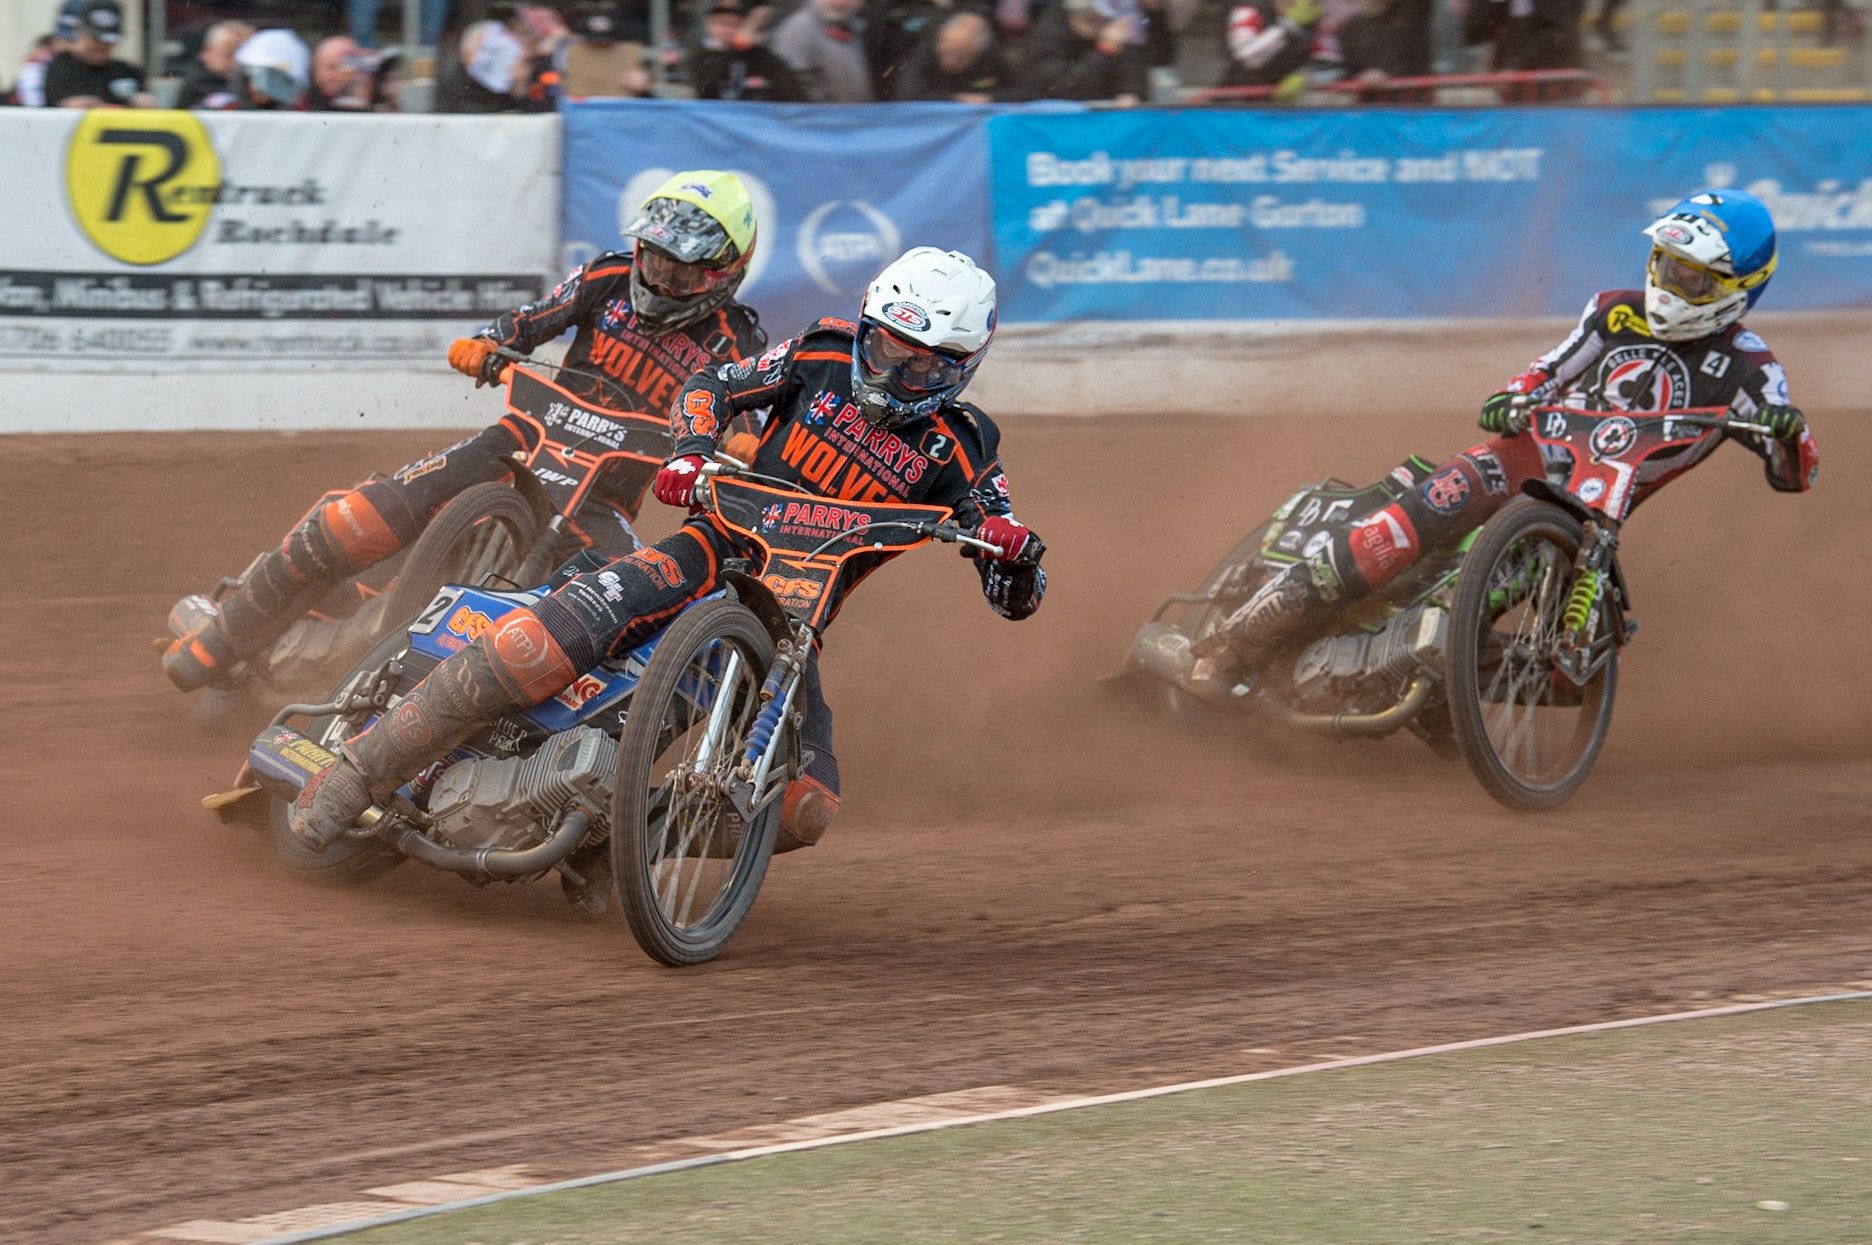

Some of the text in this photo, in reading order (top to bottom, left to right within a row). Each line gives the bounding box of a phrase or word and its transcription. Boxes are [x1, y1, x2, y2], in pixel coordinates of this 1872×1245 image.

[1026, 151, 1111, 186] Book
[1112, 157, 1187, 189] your
[1189, 154, 1267, 183] next
[1271, 150, 1388, 183] Service
[1395, 151, 1457, 183] and
[1071, 195, 1157, 234] Quick
[1160, 195, 1243, 229] Lane
[889, 306, 923, 326] STS
[833, 403, 927, 484] PARRYS
[929, 434, 947, 459] 2
[781, 421, 905, 504] WOLVE
[783, 502, 872, 536] PARRYS
[763, 574, 824, 600] CFS
[417, 595, 454, 626] 2
